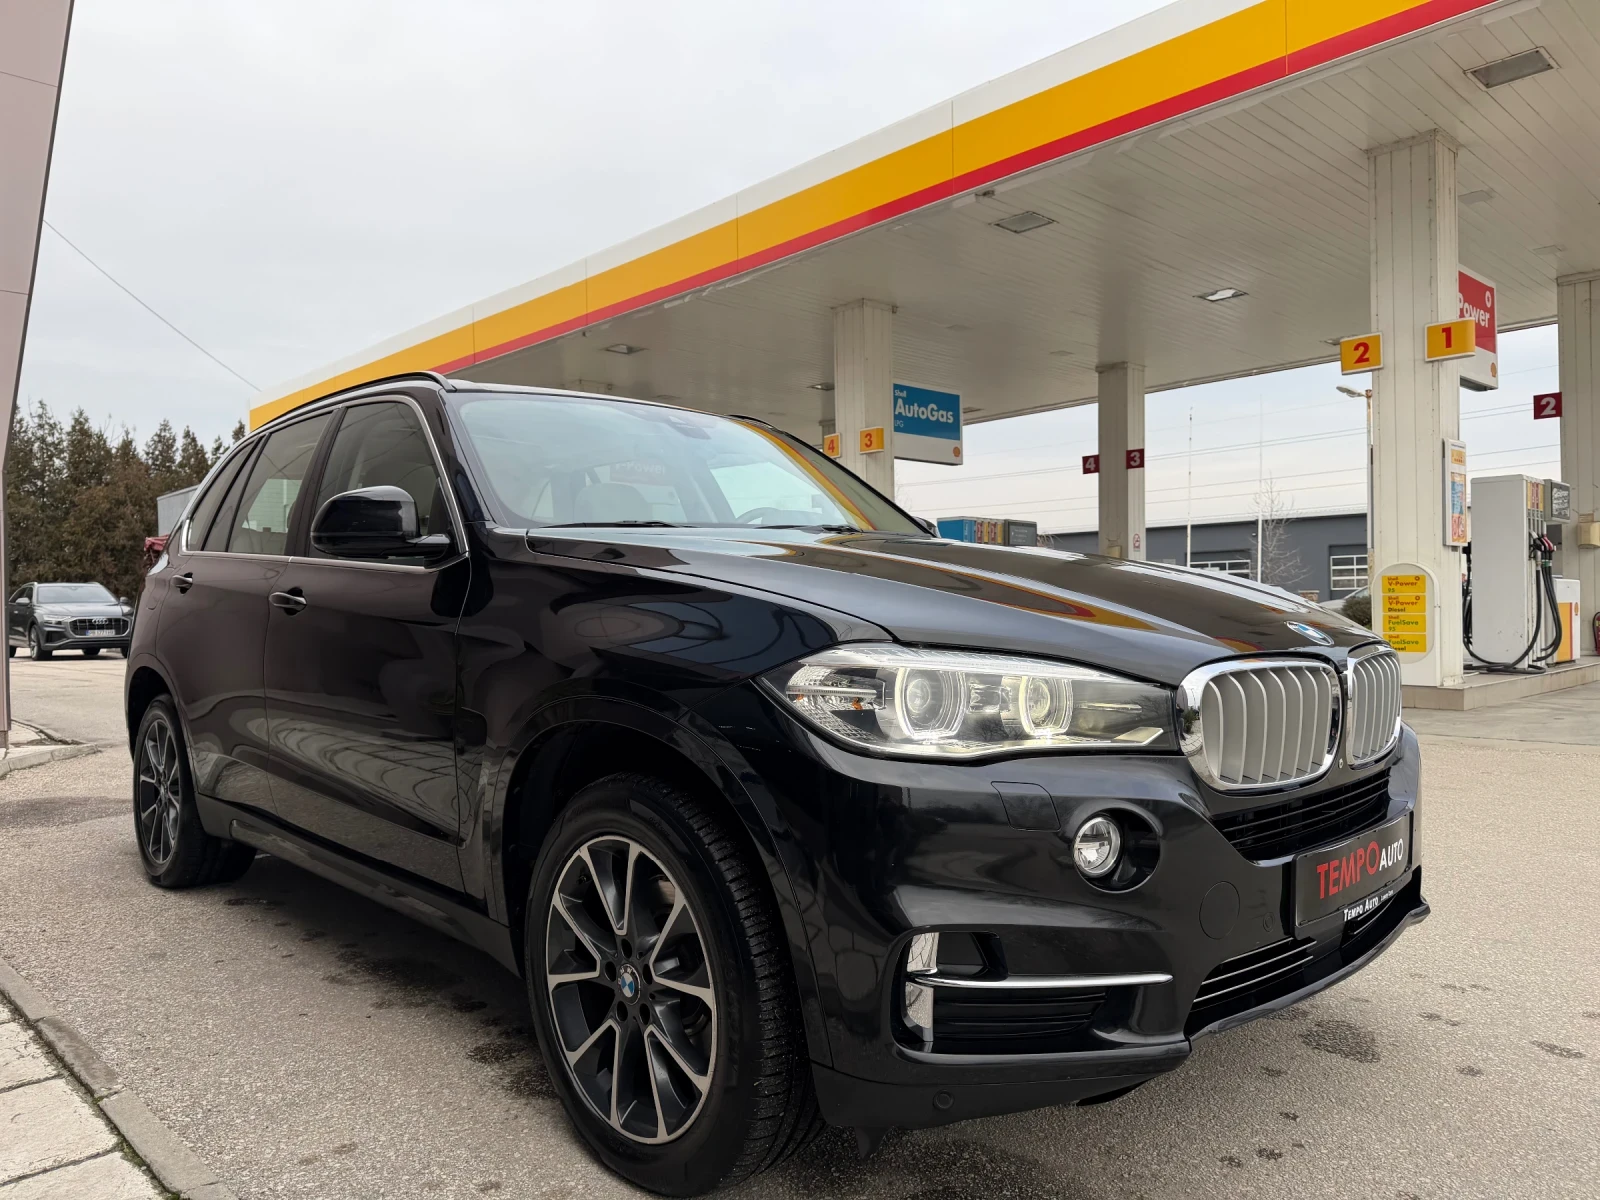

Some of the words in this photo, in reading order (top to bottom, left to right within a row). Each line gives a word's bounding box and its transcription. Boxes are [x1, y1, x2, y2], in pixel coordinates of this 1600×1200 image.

[1441, 326, 1452, 349] 1
[1353, 342, 1370, 364] 2
[894, 389, 907, 398] Shell
[894, 398, 954, 424] AutoGas
[1540, 397, 1557, 416] 2
[894, 419, 904, 428] LPG
[827, 439, 835, 453] 4
[864, 432, 873, 448] 3
[1085, 457, 1096, 471] 4
[1130, 451, 1140, 467] 3
[1316, 841, 1380, 899] TEMPO
[1378, 838, 1404, 871] AUTO
